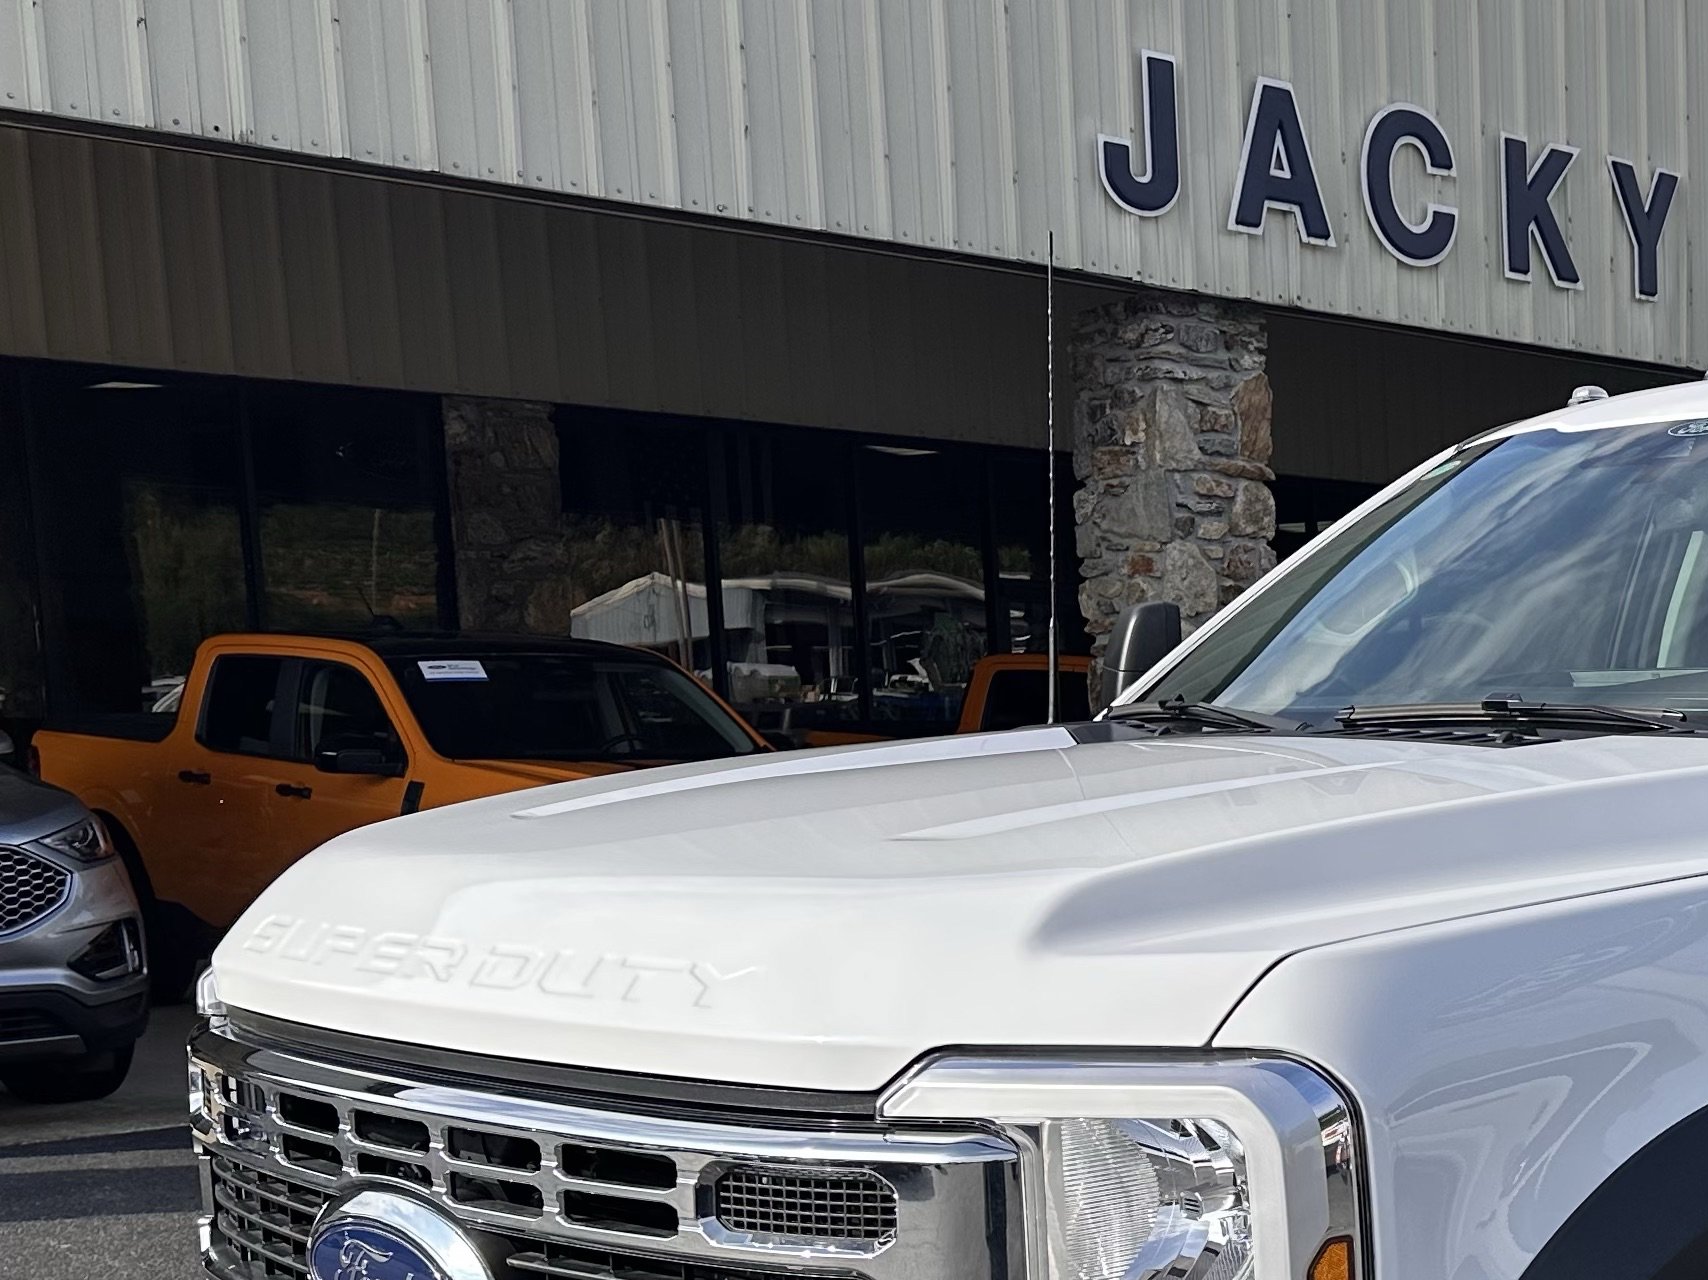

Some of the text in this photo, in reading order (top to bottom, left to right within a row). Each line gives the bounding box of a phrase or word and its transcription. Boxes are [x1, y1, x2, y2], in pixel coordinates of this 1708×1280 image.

[1098, 48, 1682, 301] JACKY
[244, 914, 762, 1010] SUPER DUTY
